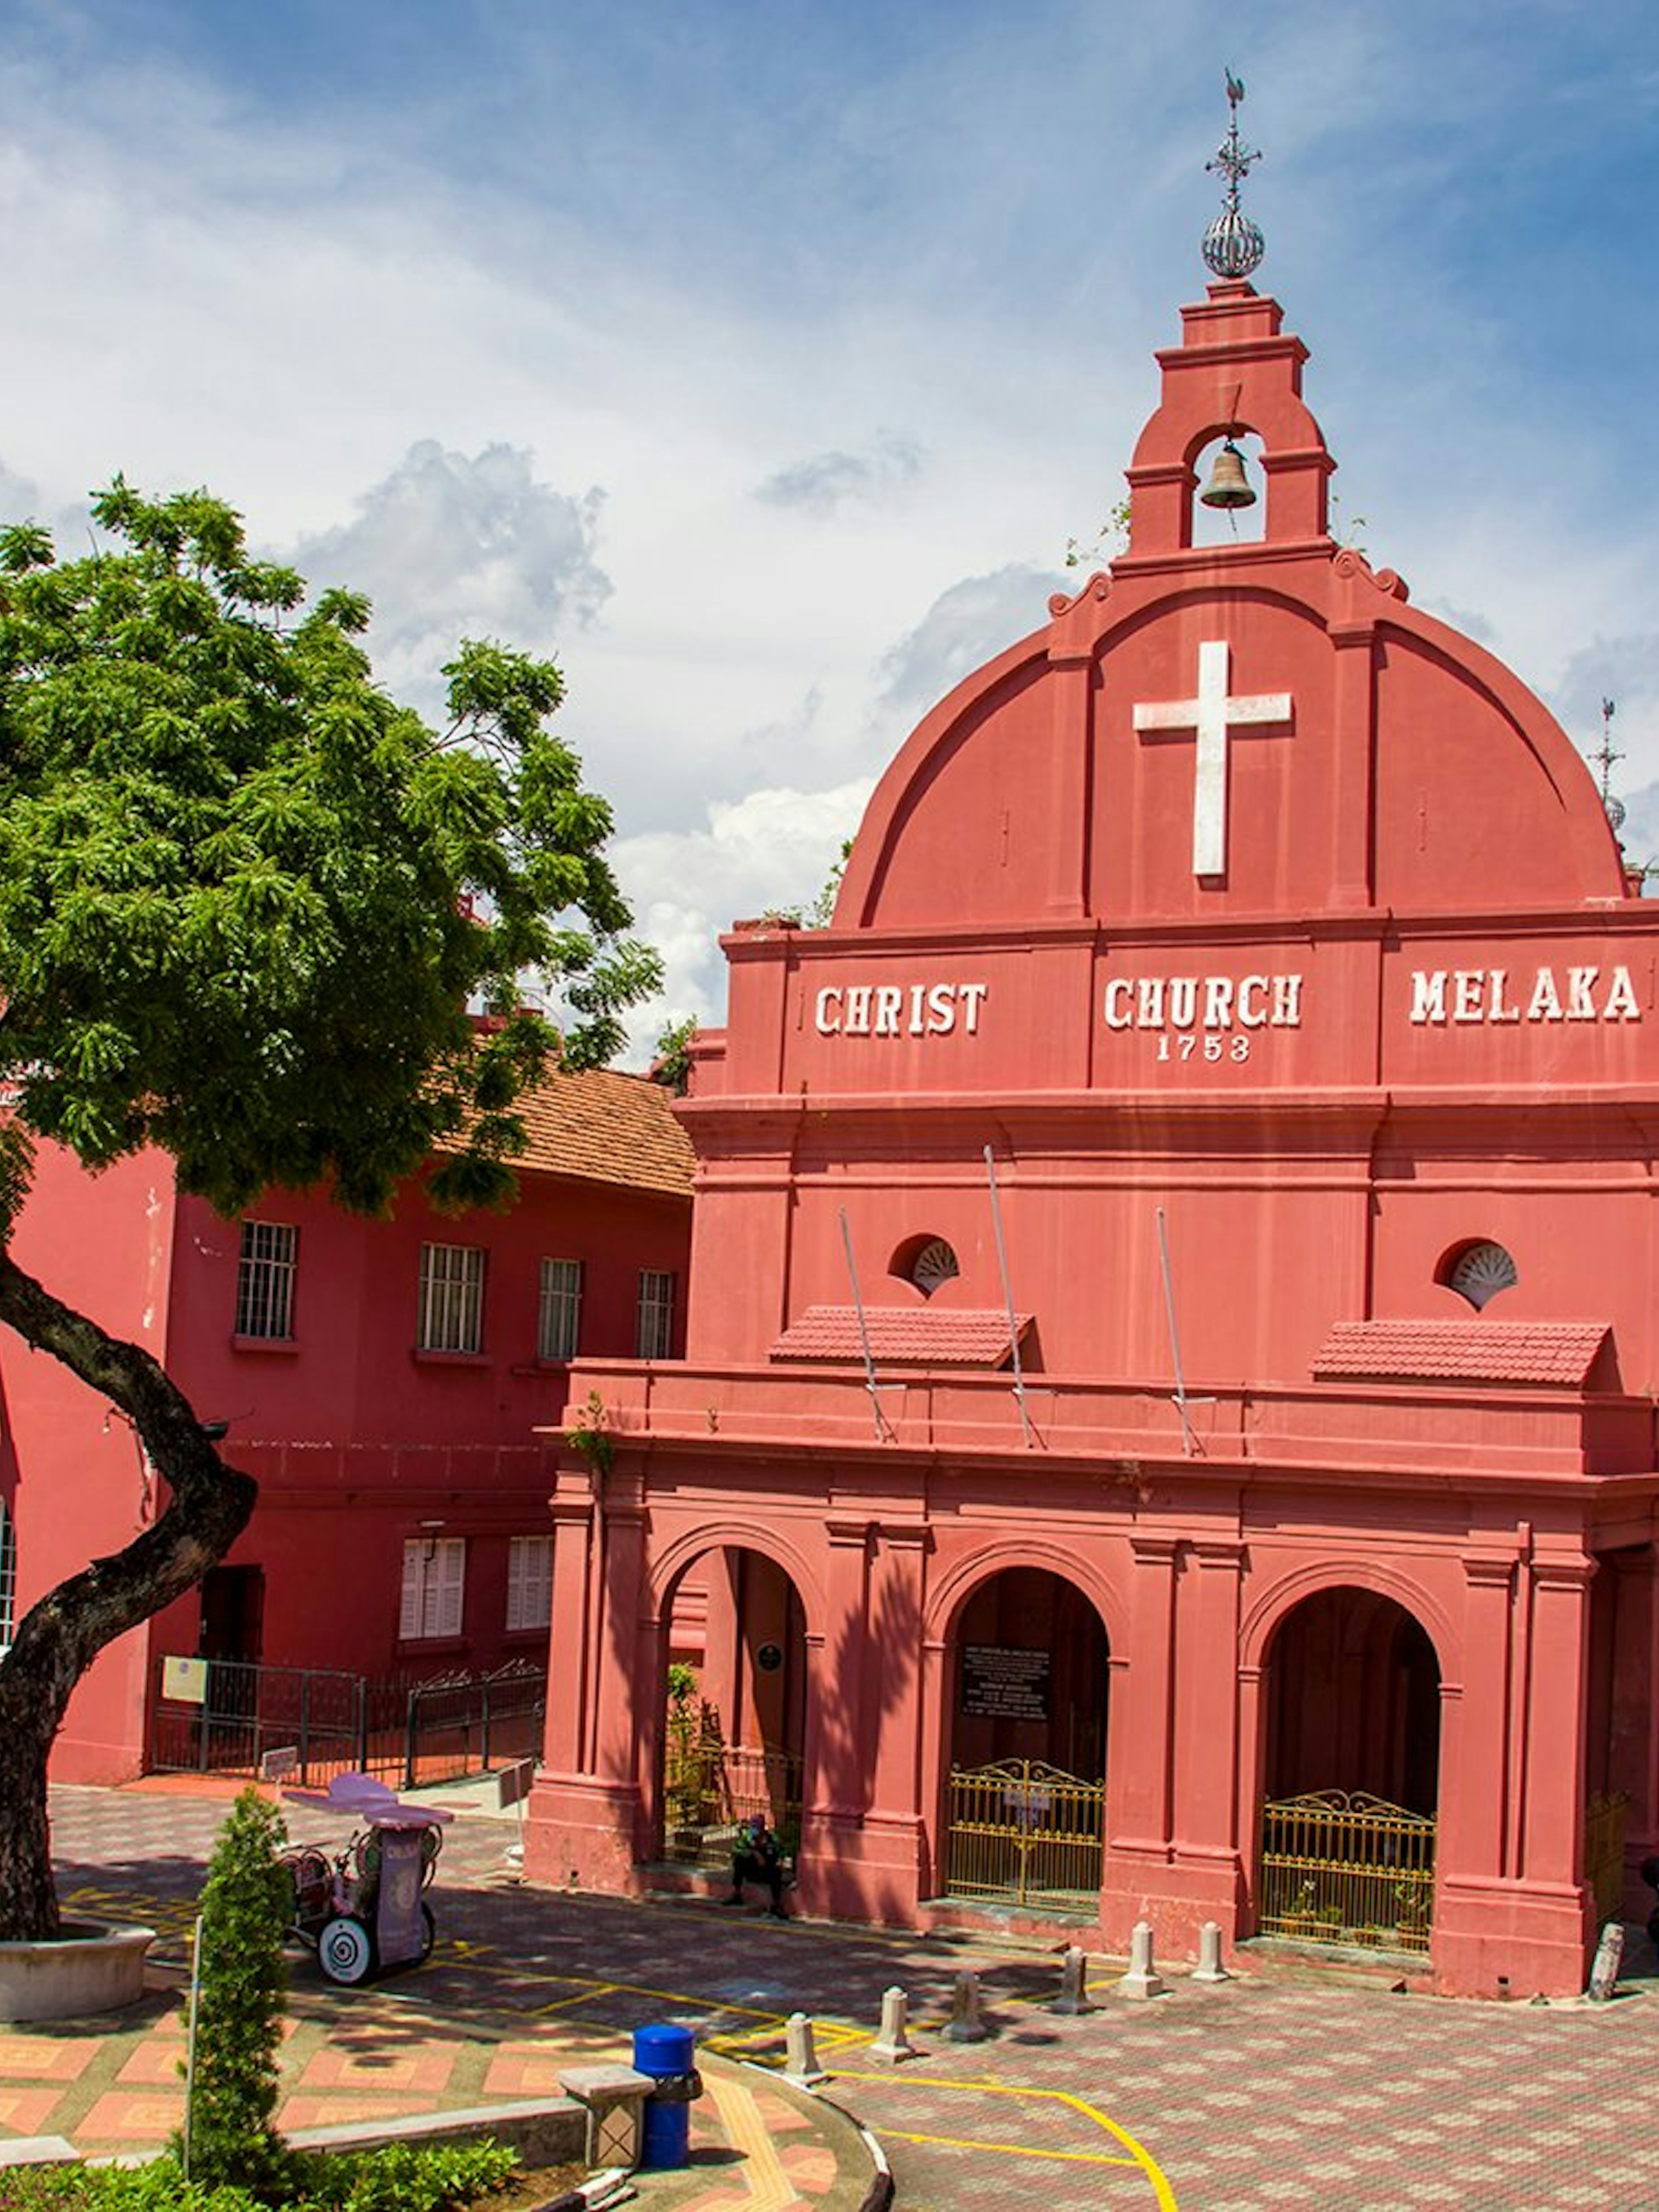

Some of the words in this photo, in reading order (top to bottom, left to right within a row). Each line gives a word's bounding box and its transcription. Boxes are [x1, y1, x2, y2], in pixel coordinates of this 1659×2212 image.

[815, 983, 987, 1034] CHRIST
[1105, 975, 1301, 1028] CHURCH
[1409, 966, 1640, 1022] MELAKA
[1157, 1034, 1249, 1062] 1753
